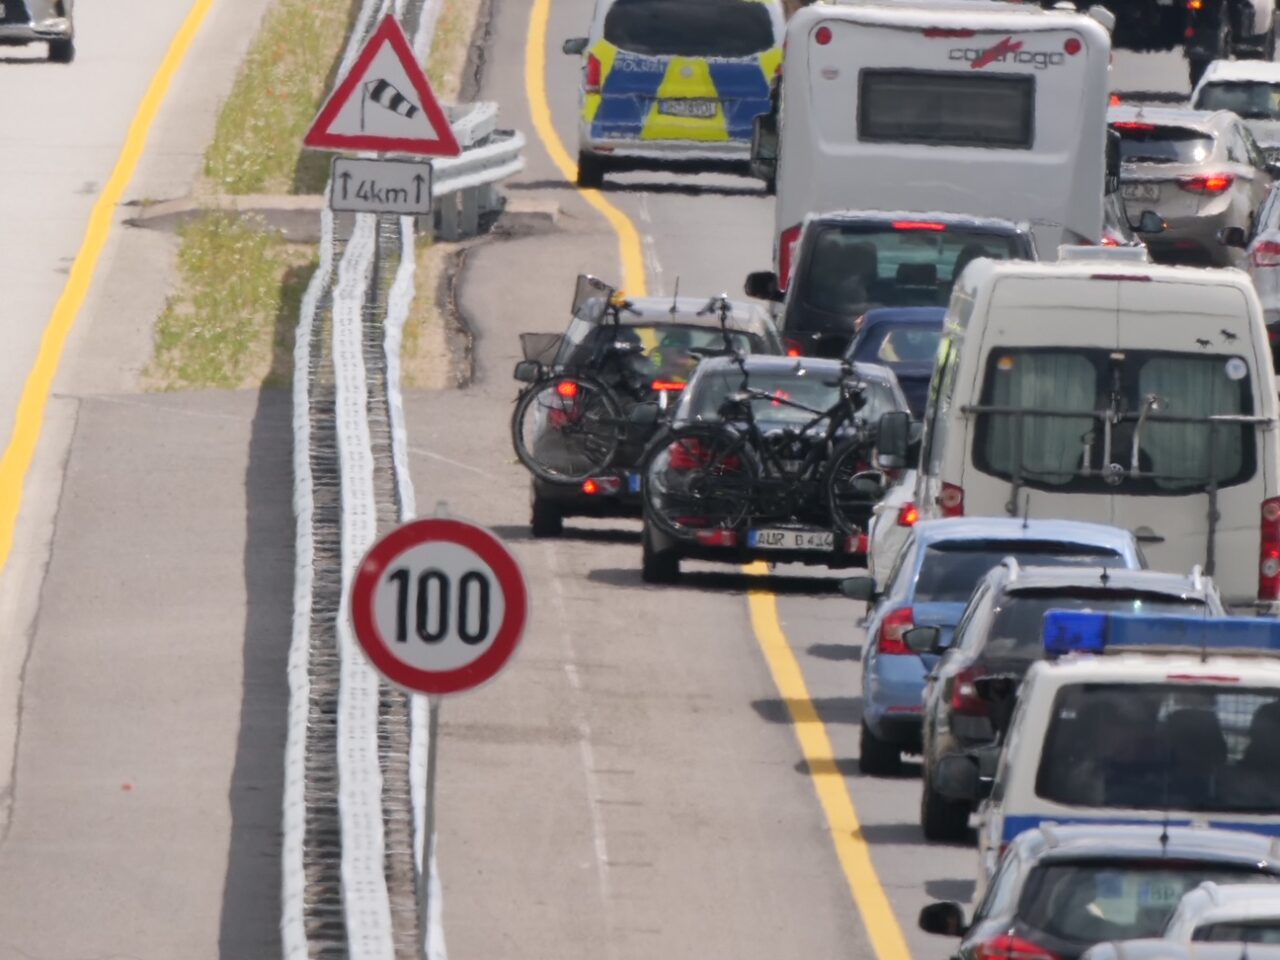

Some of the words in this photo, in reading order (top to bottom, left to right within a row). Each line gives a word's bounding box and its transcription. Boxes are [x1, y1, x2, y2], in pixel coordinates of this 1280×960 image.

[355, 179, 408, 204] 4km
[758, 531, 785, 547] AUR
[387, 567, 491, 646] 100
